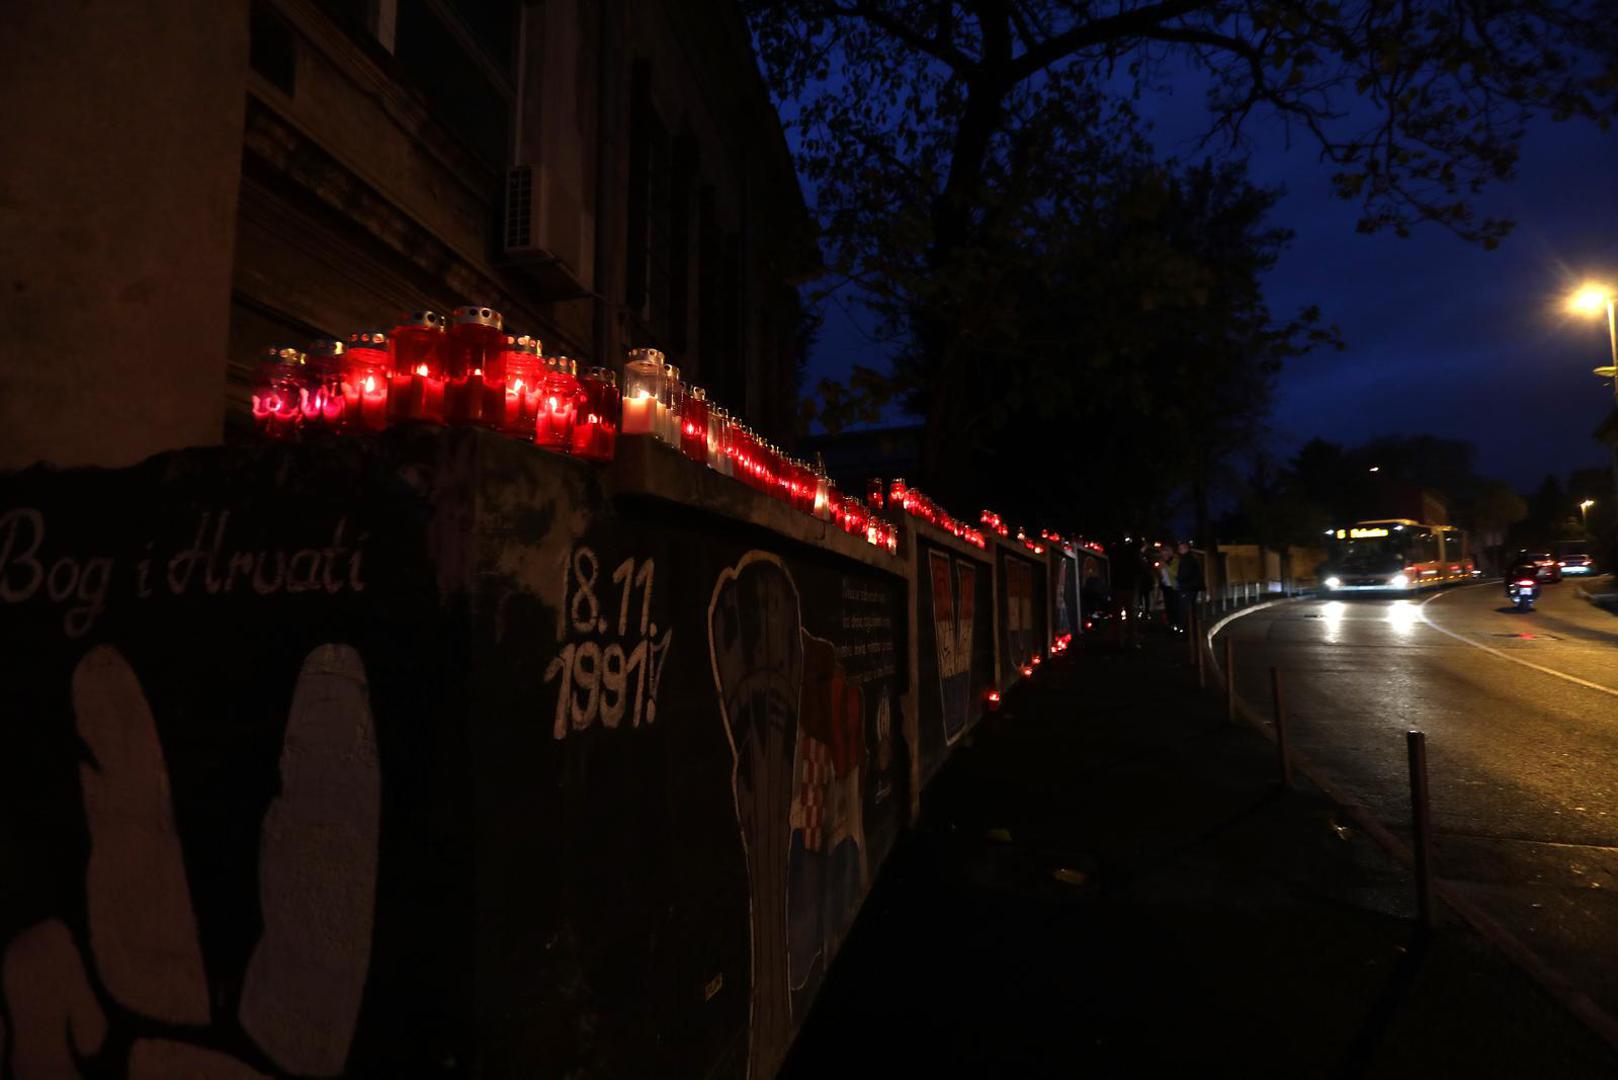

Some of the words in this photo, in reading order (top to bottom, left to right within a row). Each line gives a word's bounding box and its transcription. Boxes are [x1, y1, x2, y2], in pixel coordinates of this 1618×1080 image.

[0, 507, 114, 638] Bog
[138, 537, 155, 599] i
[166, 509, 371, 594] Hrvati
